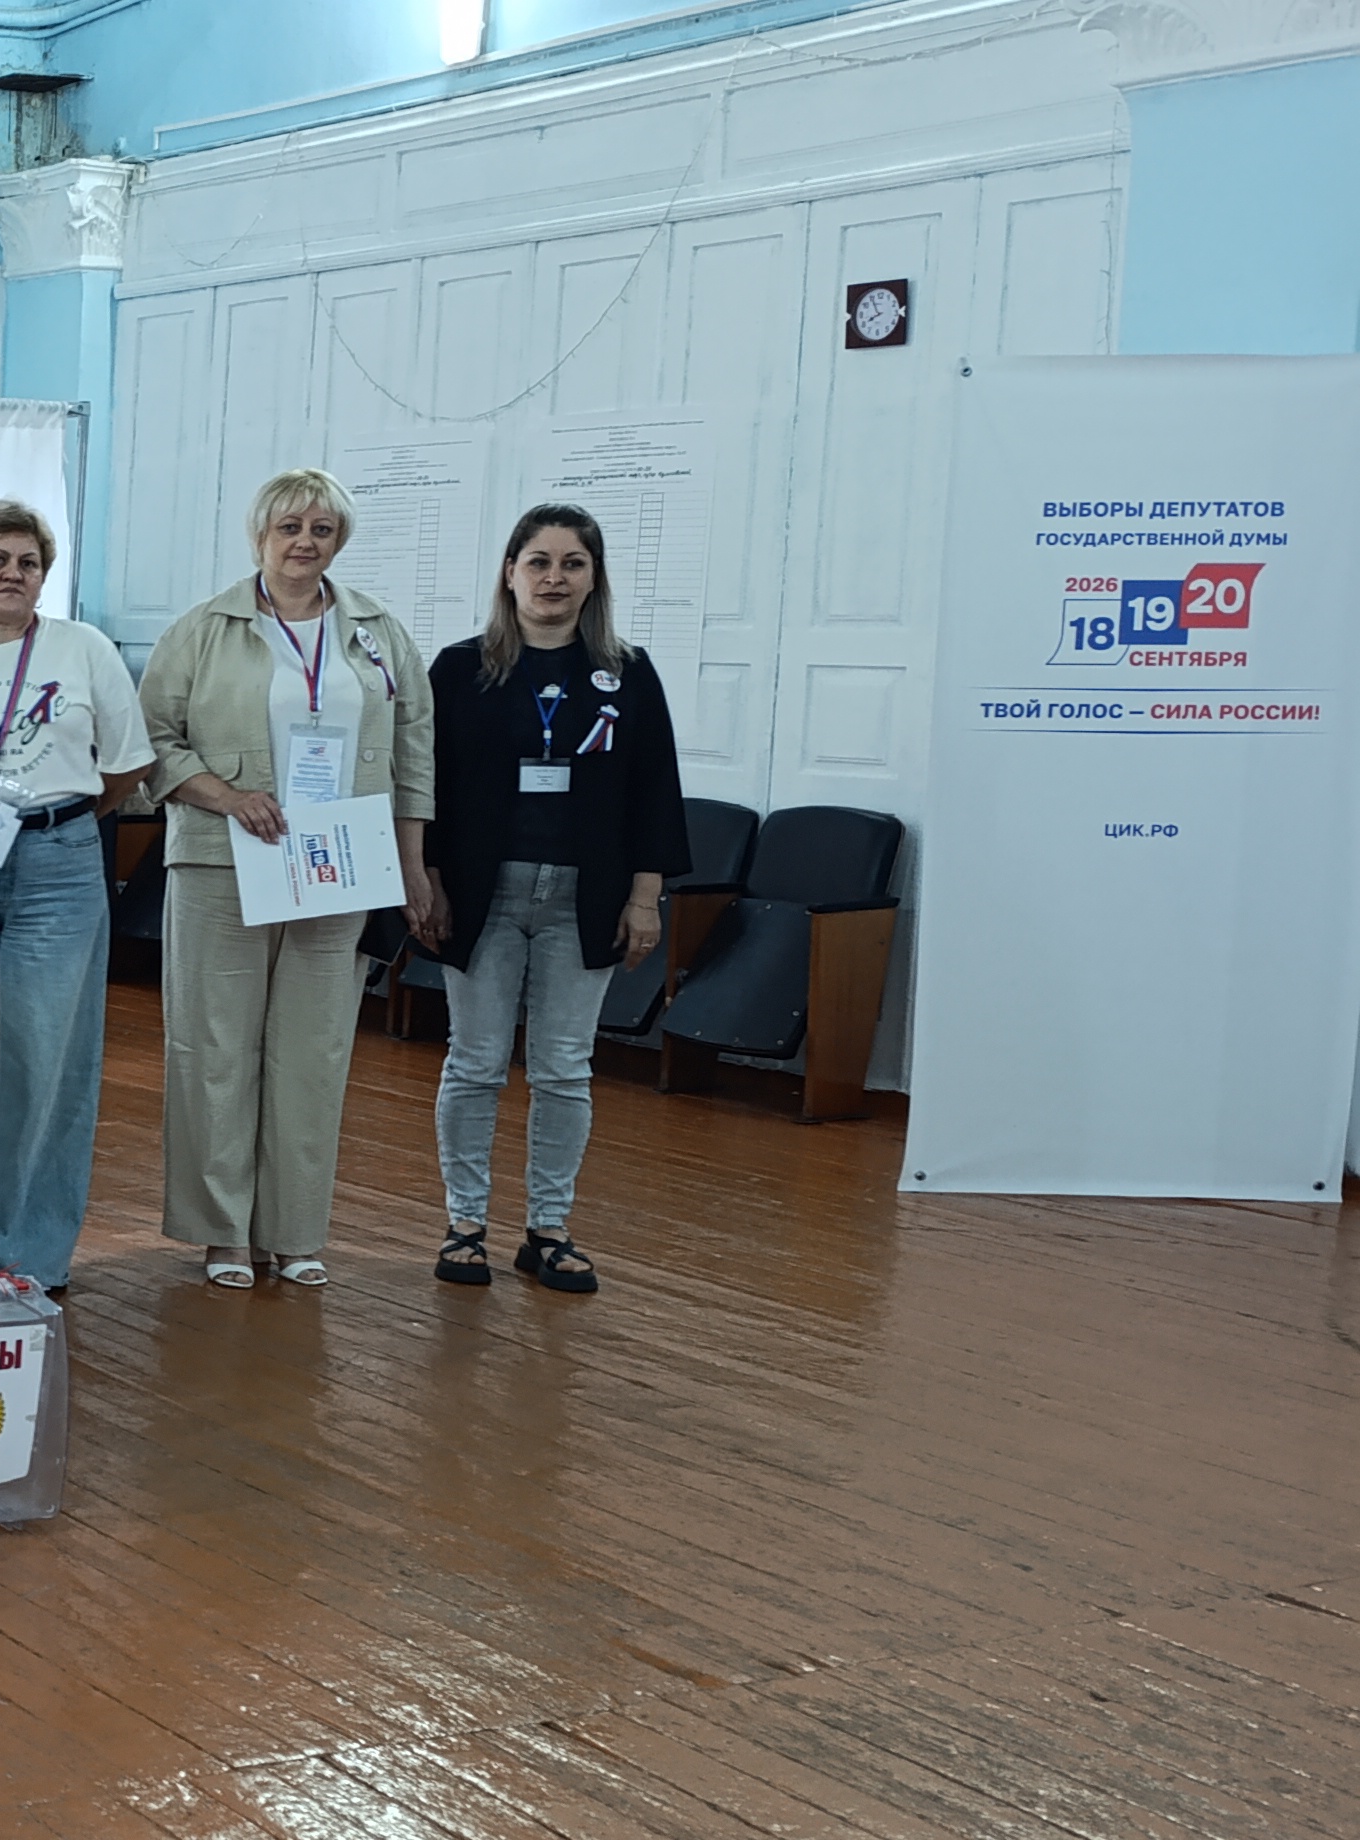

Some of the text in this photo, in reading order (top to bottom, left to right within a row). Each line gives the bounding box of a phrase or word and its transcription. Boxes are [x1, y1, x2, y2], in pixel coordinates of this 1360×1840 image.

[1042, 501, 1286, 520] ВЫБОРЫ ДЕПУТАТОВ
[1035, 529, 1288, 547] ГОСУДАРСТВЕННОЙ ДУМЫ
[1065, 577, 1118, 592] 2026
[1068, 578, 1246, 651] 18 19 20
[1129, 651, 1248, 667] СЕНТЯБРЯ
[981, 699, 1042, 719] ТВОЙ
[1047, 703, 1124, 719] ГОЛОС
[1150, 703, 1213, 720] СИЛА
[1219, 704, 1321, 721] РОССИИ!
[1103, 823, 1179, 838] ЦИК.РФ
[320, 865, 333, 881] 20
